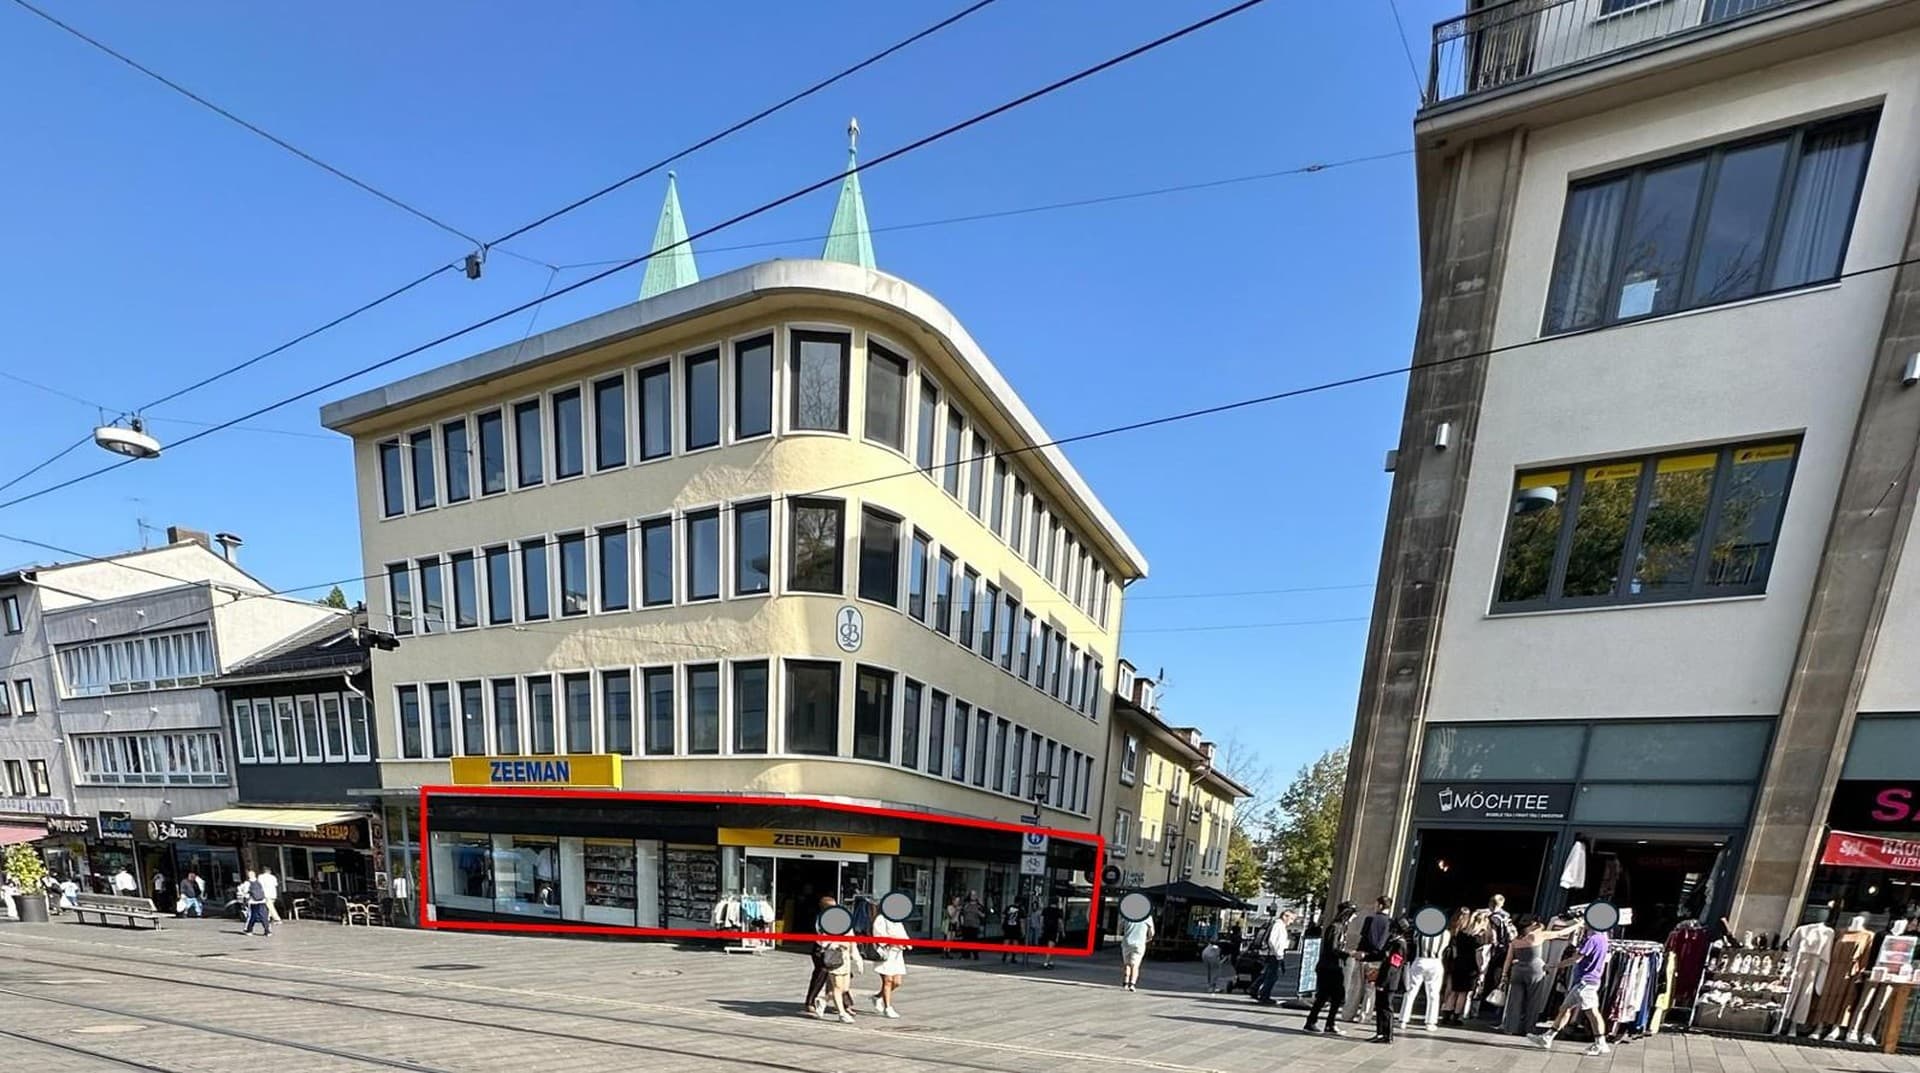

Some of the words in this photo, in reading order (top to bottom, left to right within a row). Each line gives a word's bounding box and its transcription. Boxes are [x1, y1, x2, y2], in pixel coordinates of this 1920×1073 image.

[490, 760, 570, 783] ZEEMAN
[1454, 791, 1549, 810] MÖCHTEE
[1872, 788, 1920, 822] S
[774, 833, 841, 849] ZEEMAN
